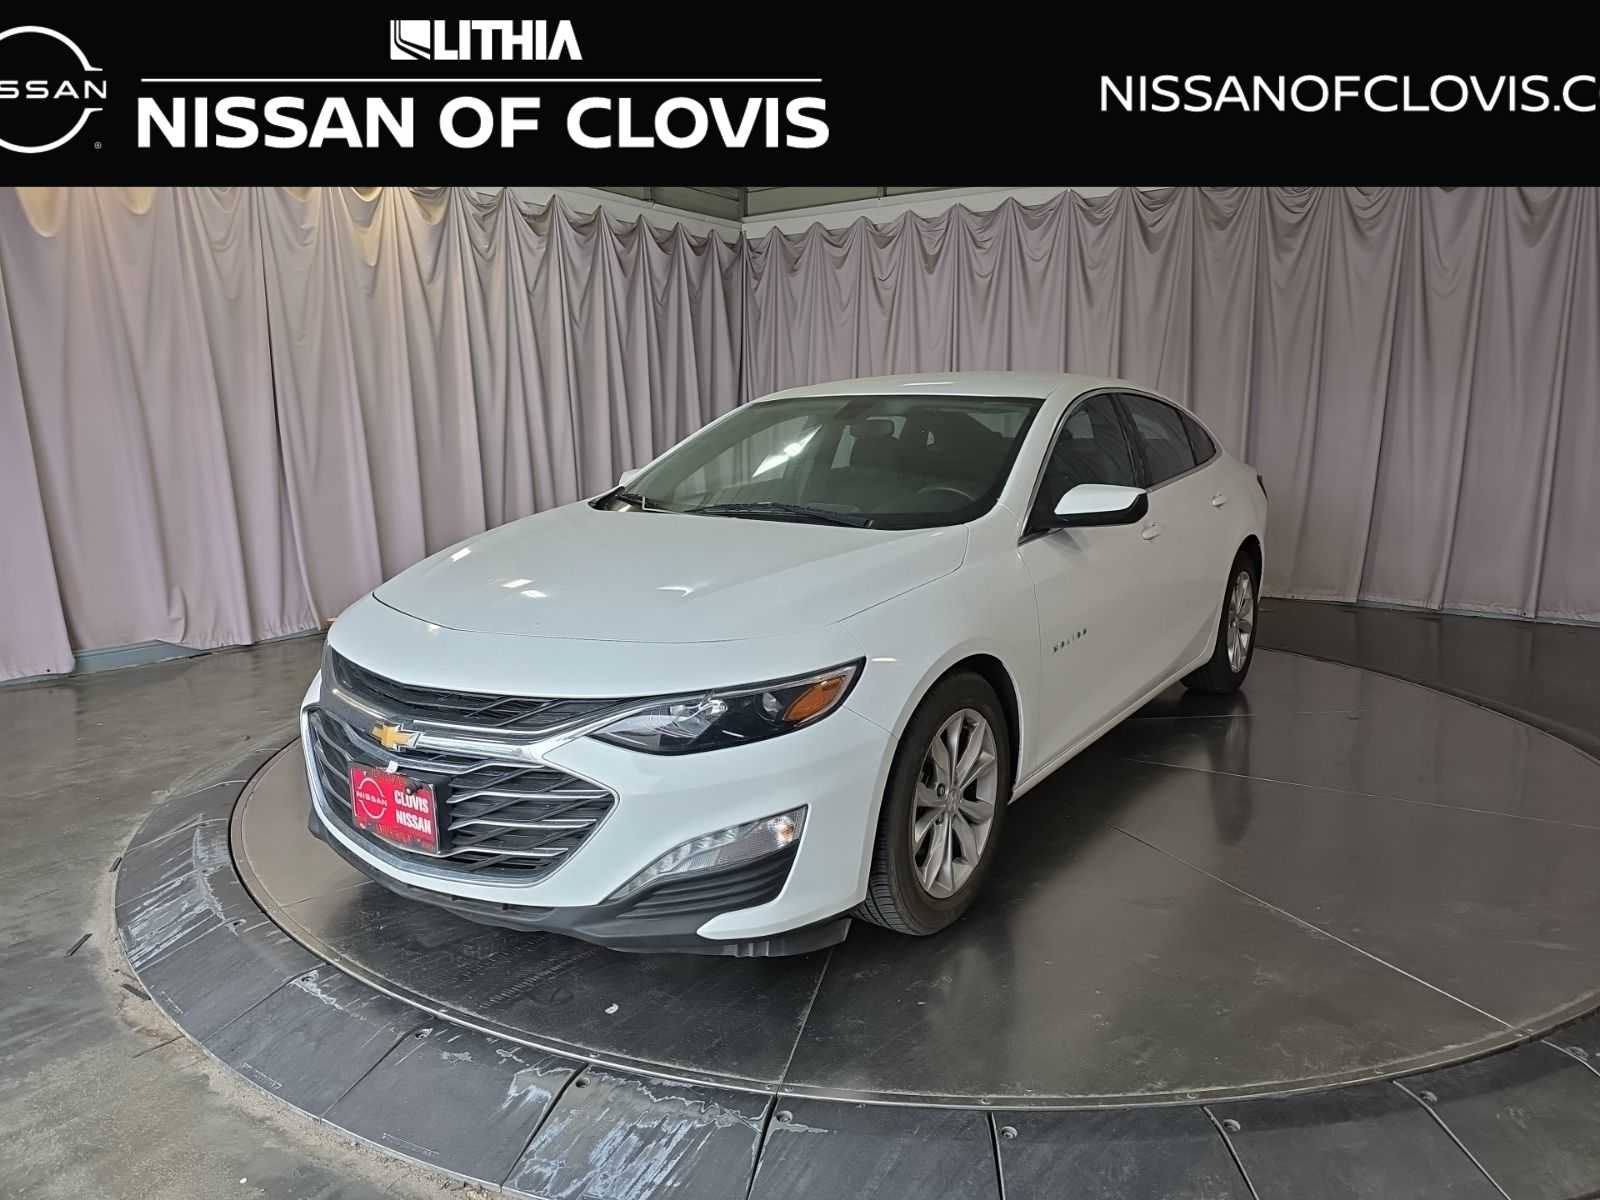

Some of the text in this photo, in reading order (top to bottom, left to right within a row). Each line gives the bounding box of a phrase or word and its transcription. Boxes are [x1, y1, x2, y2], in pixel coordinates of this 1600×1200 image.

[355, 790, 388, 807] NISSAN
[393, 789, 430, 814] CLOVIS
[395, 809, 432, 835] NISSAN
